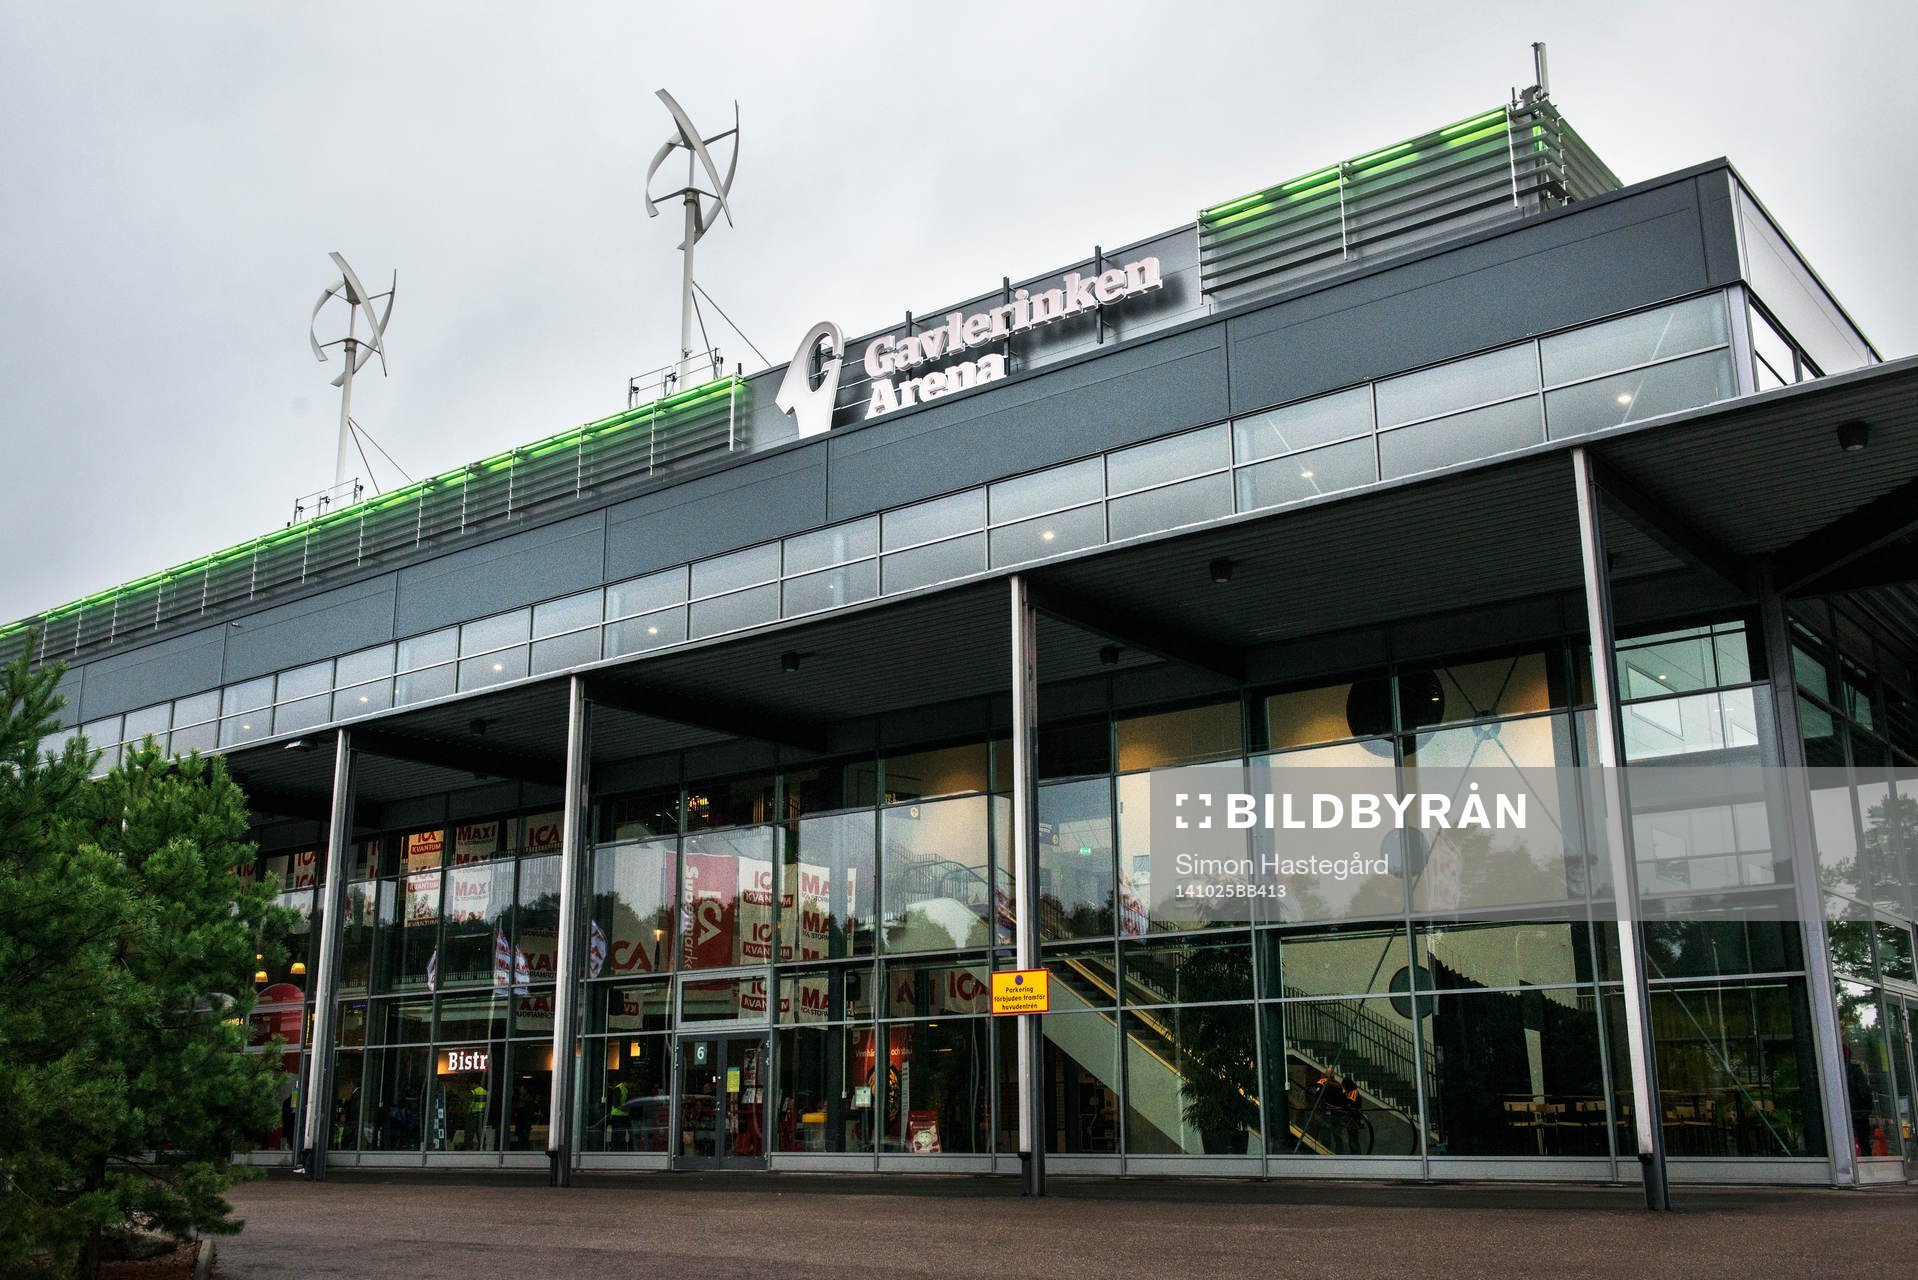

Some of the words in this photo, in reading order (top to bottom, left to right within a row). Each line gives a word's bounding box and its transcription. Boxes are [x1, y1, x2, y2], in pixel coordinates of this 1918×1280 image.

[864, 256, 1163, 379] Gavlerinken
[865, 353, 1008, 420] Arena
[754, 870, 772, 891] IC
[698, 890, 722, 946] ICA
[753, 922, 772, 943] IC
[611, 940, 652, 972] CA
[447, 1051, 489, 1071] Bistr
[697, 1046, 705, 1060] 6
